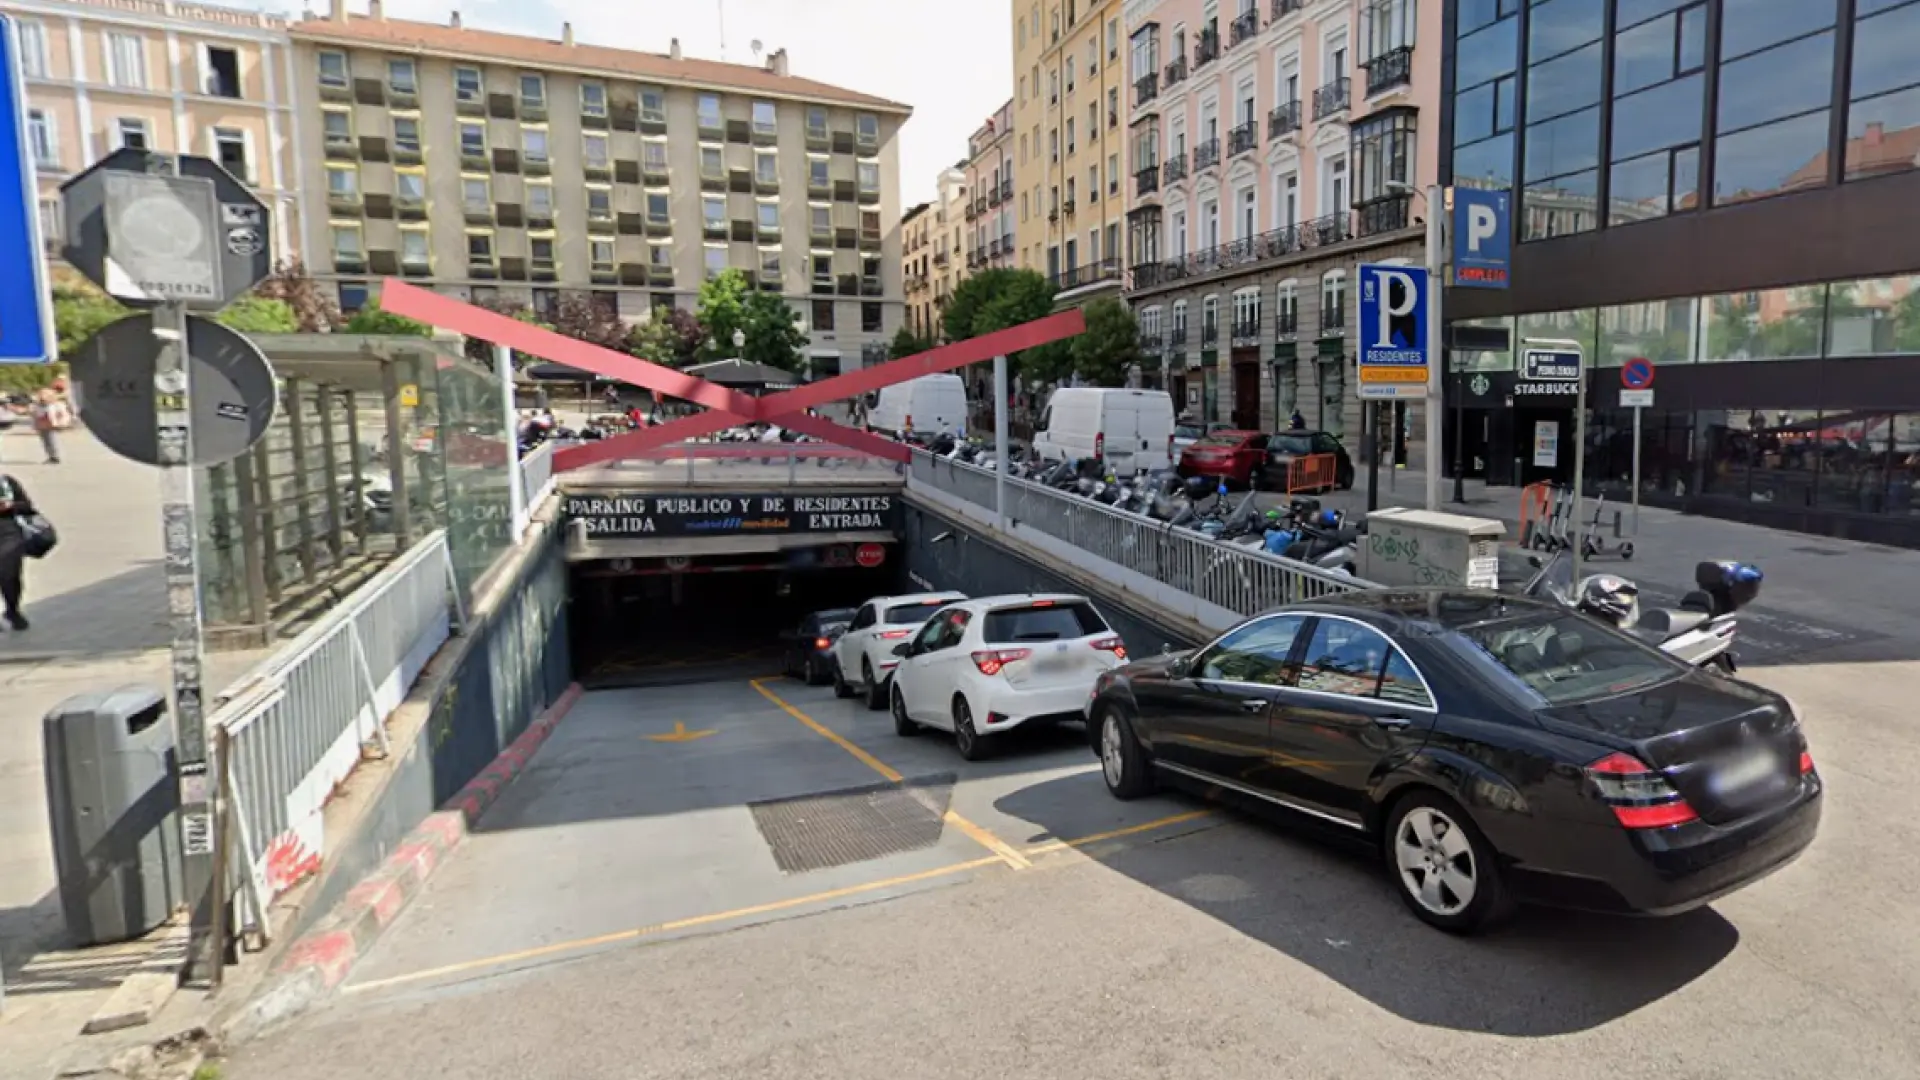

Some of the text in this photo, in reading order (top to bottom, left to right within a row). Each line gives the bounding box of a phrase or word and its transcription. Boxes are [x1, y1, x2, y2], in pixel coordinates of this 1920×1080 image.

[1468, 204, 1497, 252] P
[1371, 269, 1418, 348] P
[1367, 350, 1422, 363] RESIDENTES
[1514, 383, 1586, 395] STARBUCK
[569, 497, 891, 514] PARKING PUBLICO Y DE RESIDENTES
[586, 517, 656, 533] SALIDA
[809, 513, 882, 529] ENTRADA
